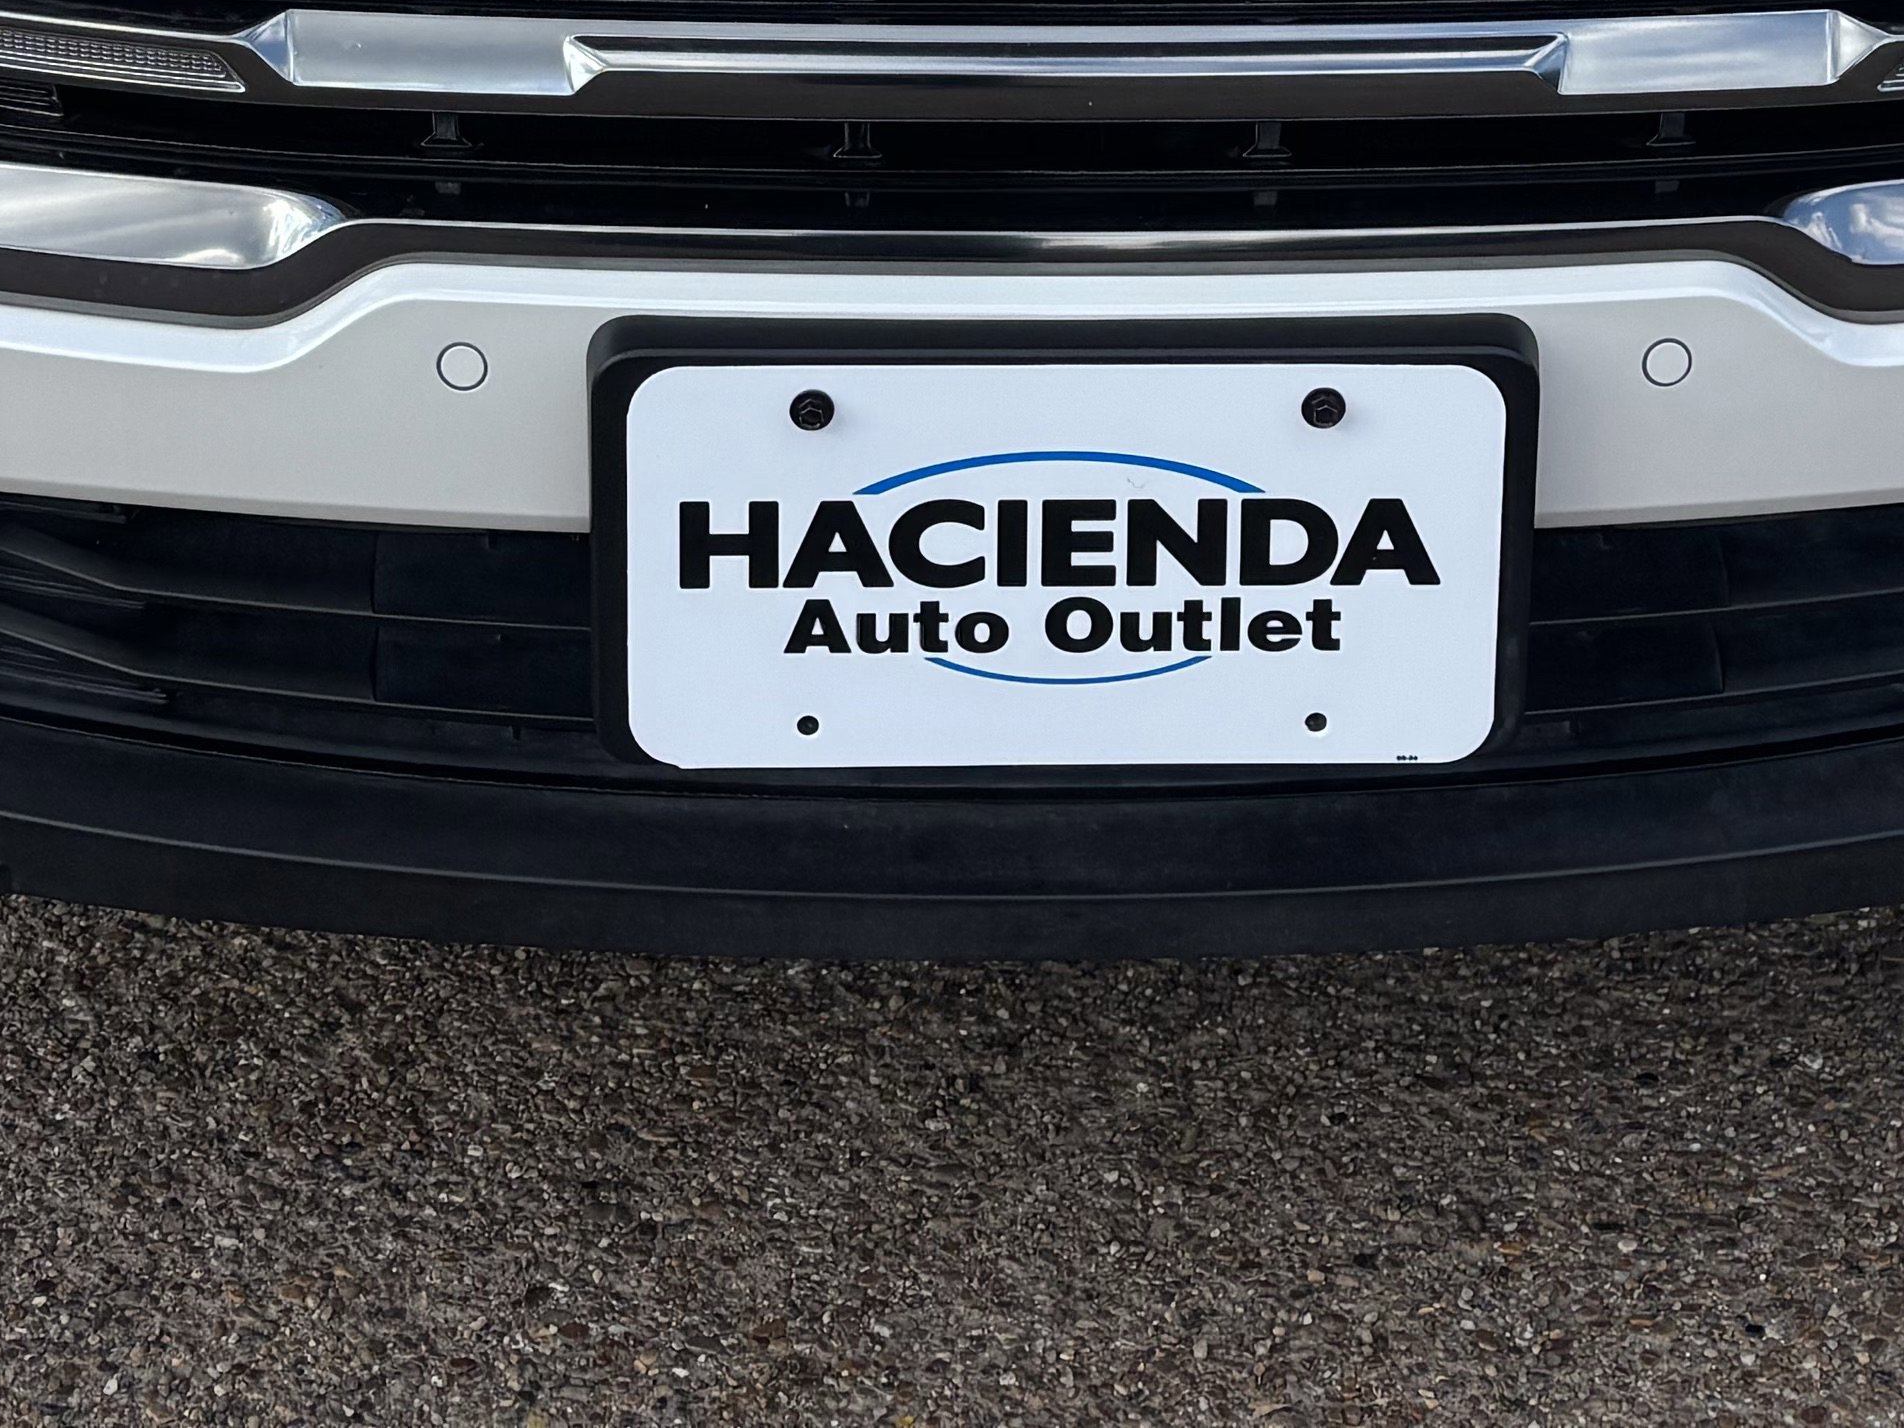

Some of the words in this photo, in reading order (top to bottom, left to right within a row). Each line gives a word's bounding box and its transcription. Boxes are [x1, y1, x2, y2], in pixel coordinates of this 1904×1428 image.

[678, 498, 1442, 590] HACIENDA
[783, 598, 1010, 655] Auto
[1043, 595, 1342, 653] Outlet
